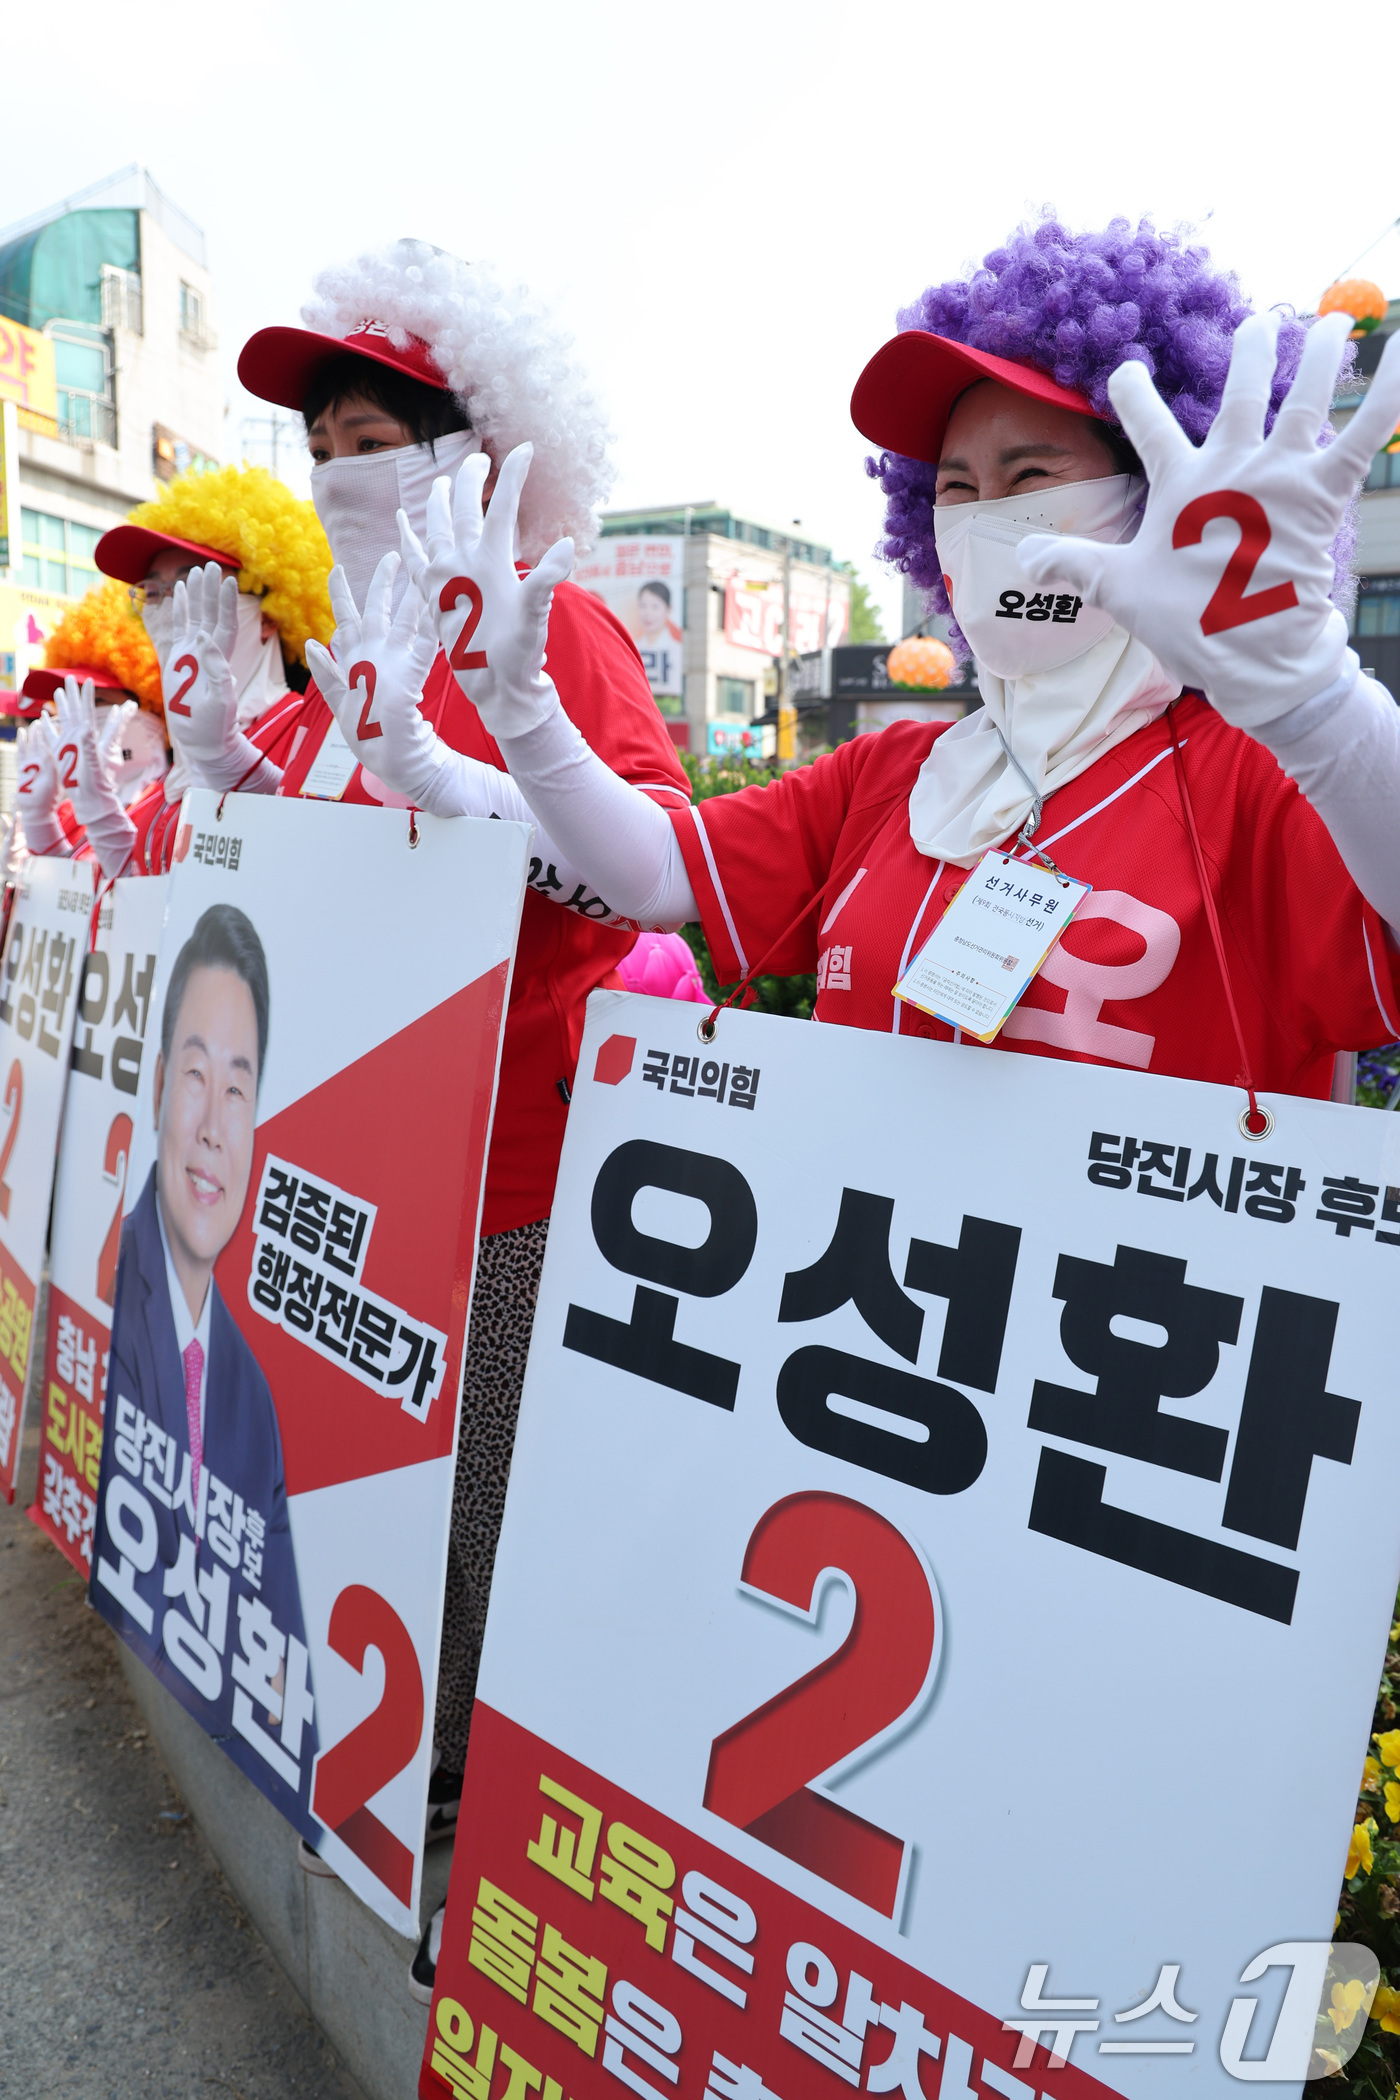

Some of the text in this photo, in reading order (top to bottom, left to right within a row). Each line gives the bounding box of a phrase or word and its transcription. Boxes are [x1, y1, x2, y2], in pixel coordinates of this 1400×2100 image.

[995, 590, 1083, 623] 오성환
[1172, 490, 1299, 636] 2
[438, 576, 488, 671] 2
[168, 654, 199, 717] 2
[349, 661, 383, 741] 2
[19, 764, 40, 793] 2
[58, 743, 78, 788] 2
[194, 833, 242, 871] 국민의힘
[984, 876, 1060, 915] 선거사무원
[0, 922, 76, 1060] 오성환
[642, 1049, 761, 1111] 국민의힘
[259, 1167, 368, 1279] 검증된
[1088, 1131, 1306, 1224] 당진시장
[56, 1315, 98, 1404] 충남
[253, 1242, 438, 1409] 행정전문가
[562, 1138, 1362, 1626] 오성환
[115, 1394, 245, 1569] 당진시장
[241, 1507, 266, 1590] 후보
[97, 1475, 315, 1793] 오성환
[313, 1583, 425, 1910] 2
[703, 1490, 938, 1922] 2
[526, 1774, 757, 2009] 교육은
[468, 1876, 682, 2100] 돌봄은
